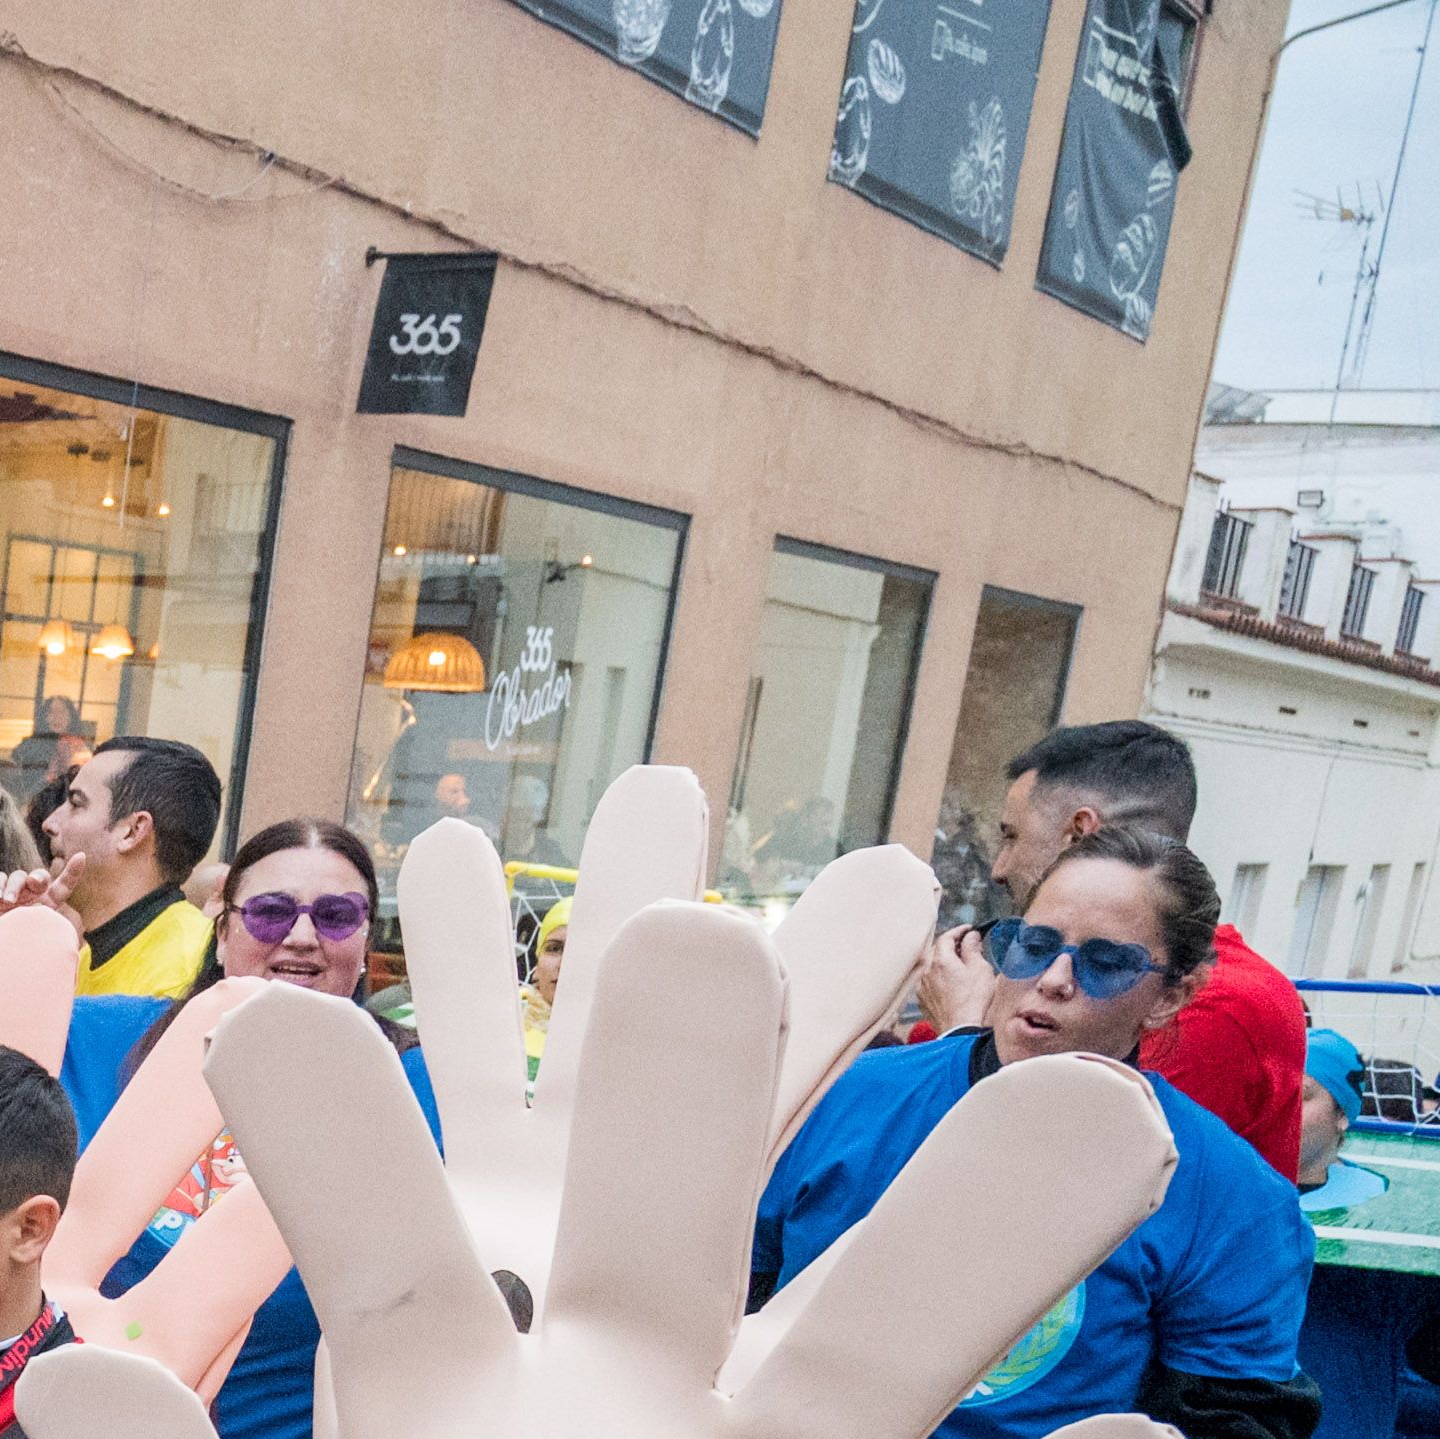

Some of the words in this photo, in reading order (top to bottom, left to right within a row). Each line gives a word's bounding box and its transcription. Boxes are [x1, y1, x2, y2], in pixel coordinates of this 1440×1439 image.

[389, 313, 463, 356] 365
[521, 625, 554, 671] 365
[485, 660, 572, 751] Obrador
